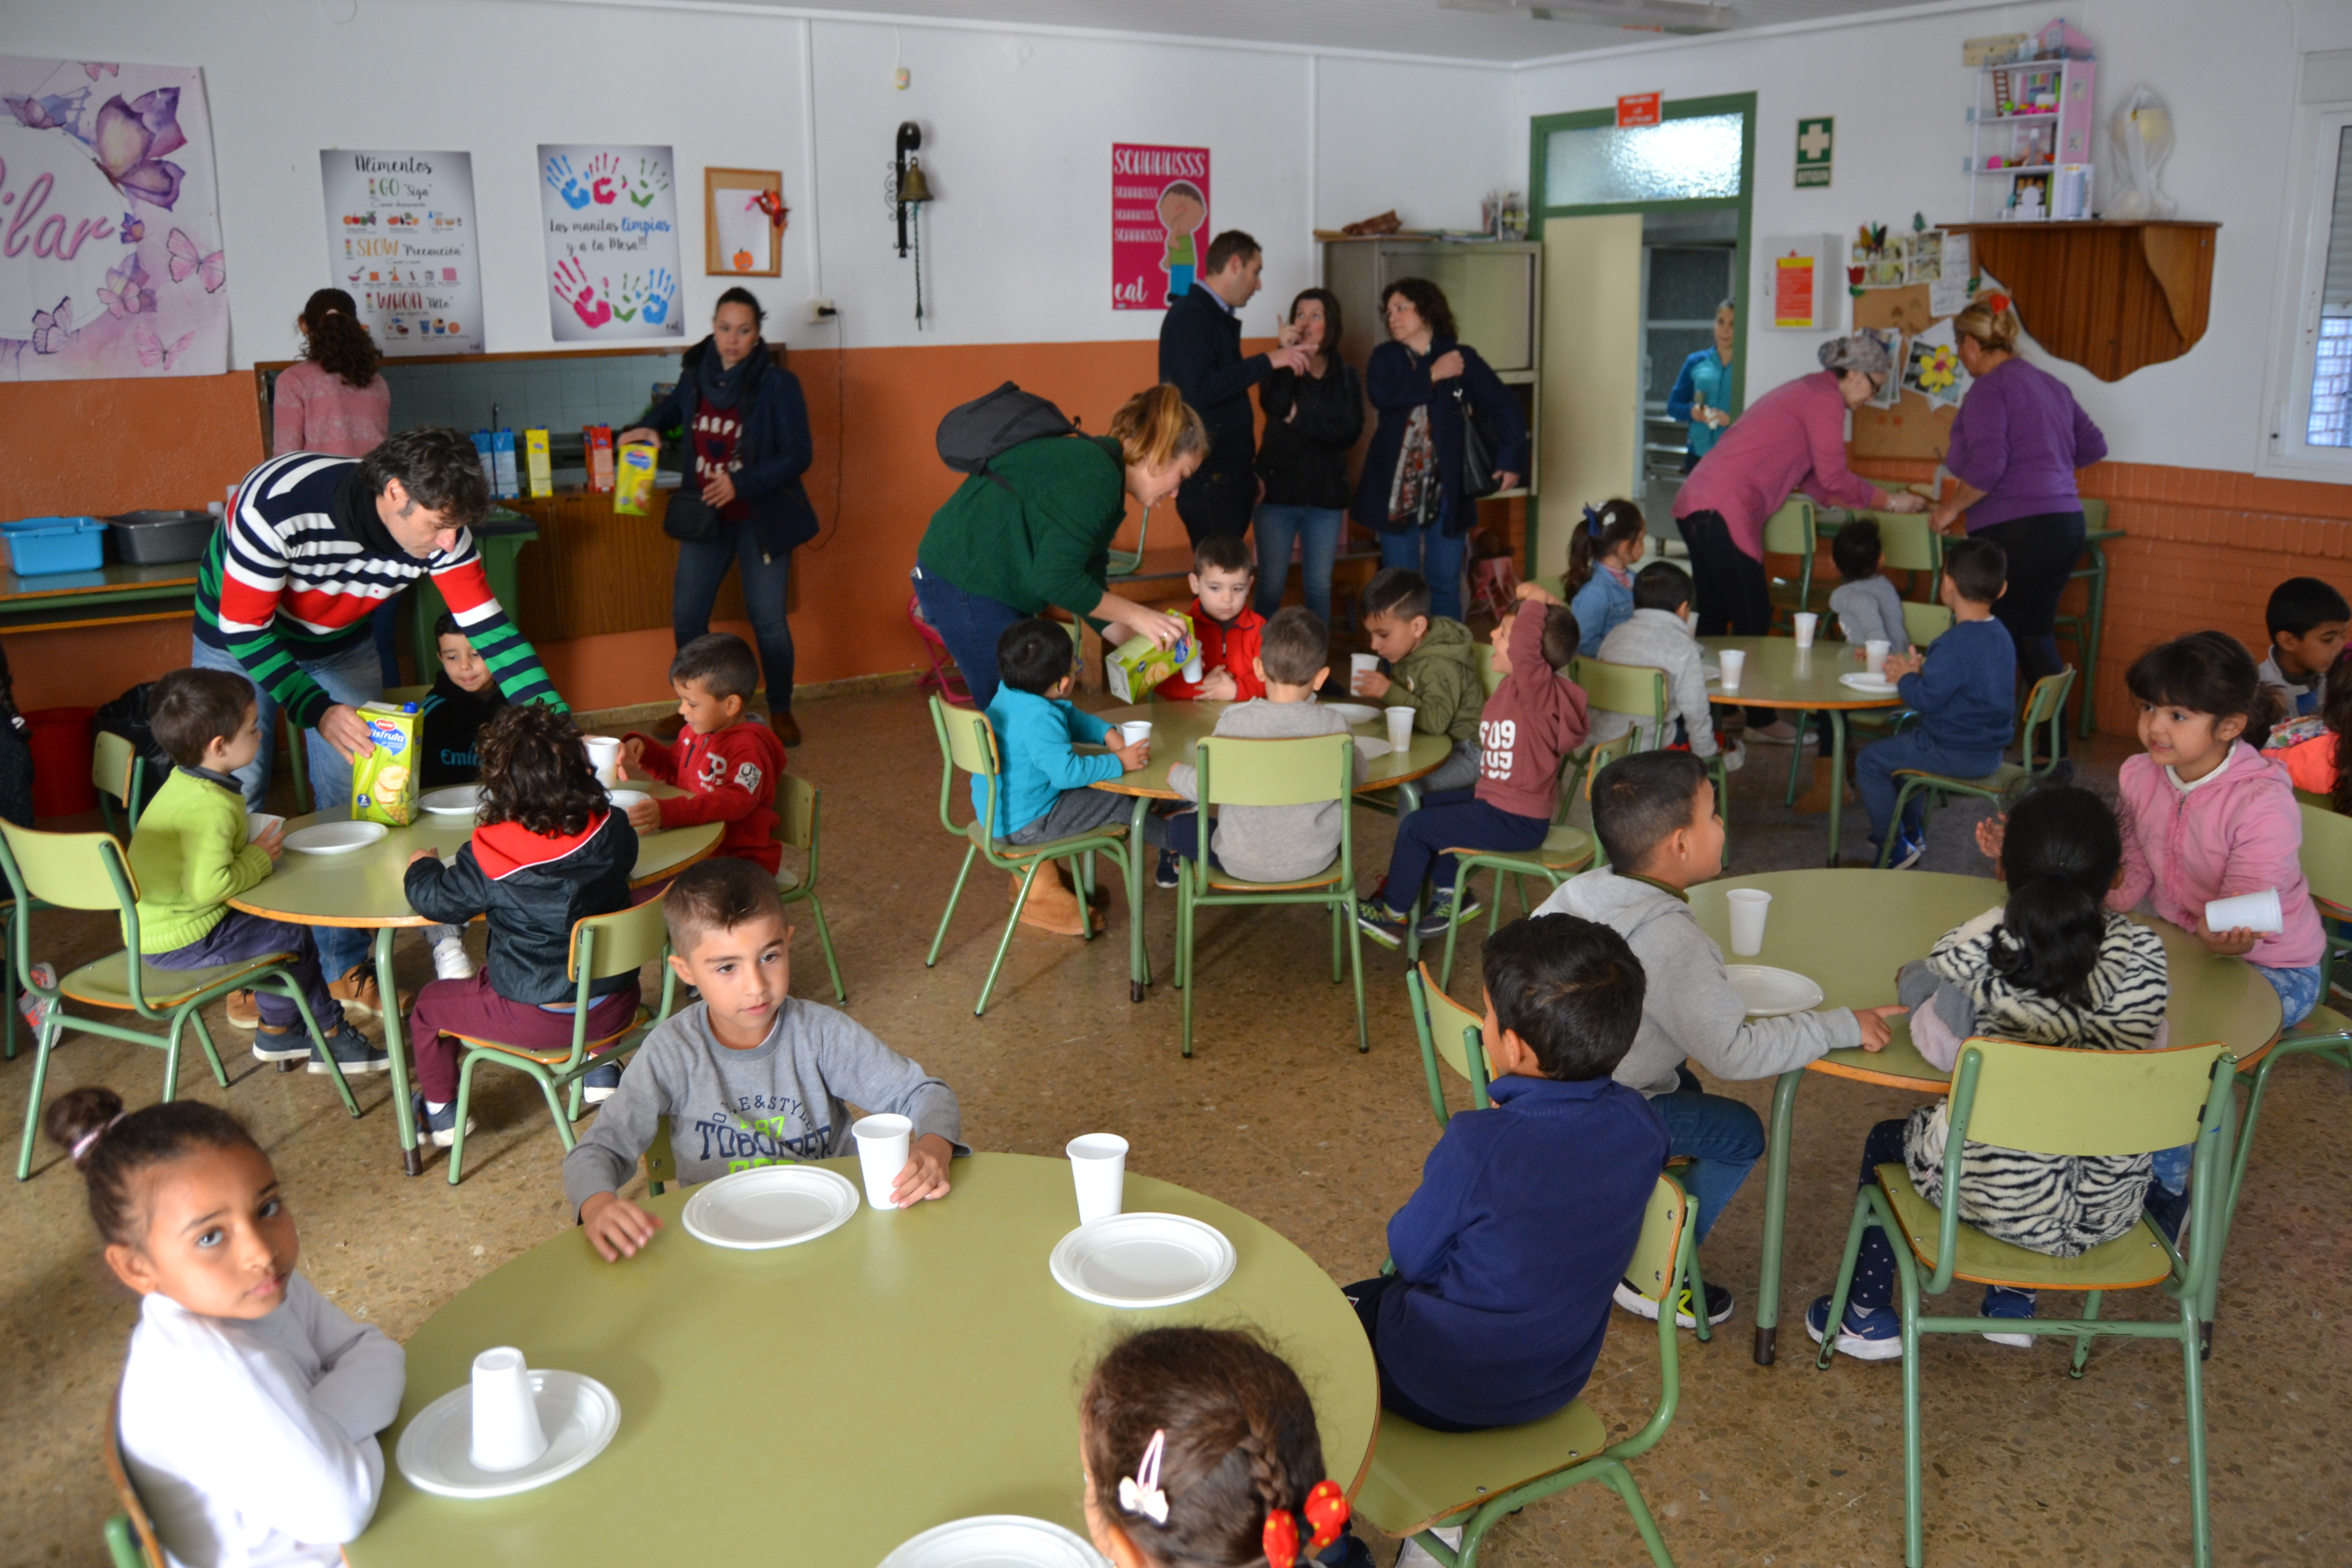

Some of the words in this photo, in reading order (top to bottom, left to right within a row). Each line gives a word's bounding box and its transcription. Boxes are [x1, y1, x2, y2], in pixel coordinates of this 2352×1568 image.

[355, 154, 432, 175] Alimentos
[379, 178, 399, 197] GO
[0, 156, 114, 261] lar
[622, 216, 671, 237] limpias
[357, 237, 399, 256] SLOW
[567, 242, 574, 256] y
[579, 242, 586, 251] a
[592, 239, 604, 251] la
[371, 728, 405, 743] isfruta
